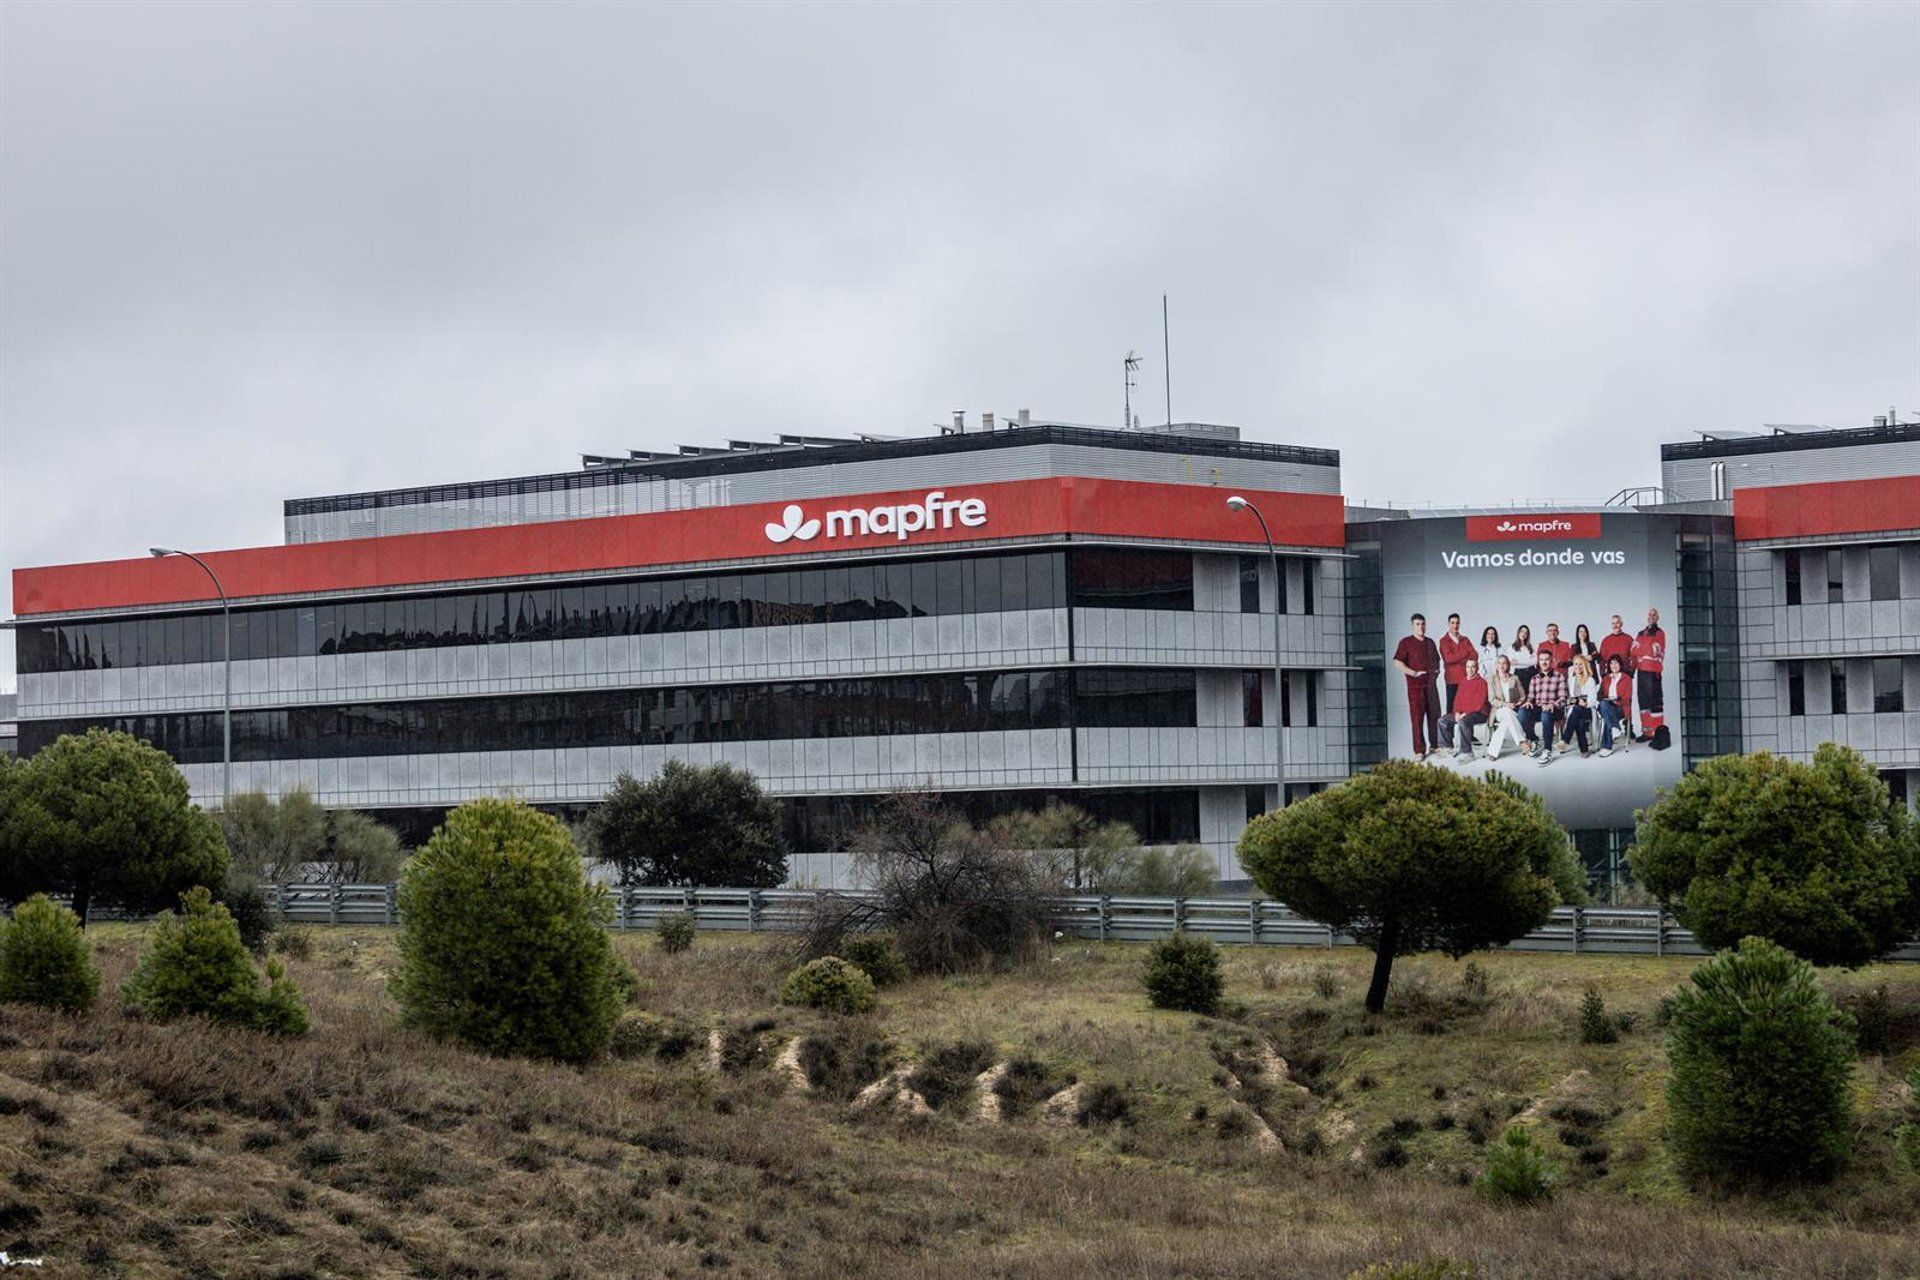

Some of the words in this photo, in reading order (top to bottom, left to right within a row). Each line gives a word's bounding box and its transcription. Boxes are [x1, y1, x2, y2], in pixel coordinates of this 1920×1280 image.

[827, 491, 987, 540] mapfre
[1518, 520, 1571, 533] mapfre
[1441, 551, 1514, 568] Vamos
[1518, 549, 1584, 566] donde
[1592, 551, 1625, 565] vas
